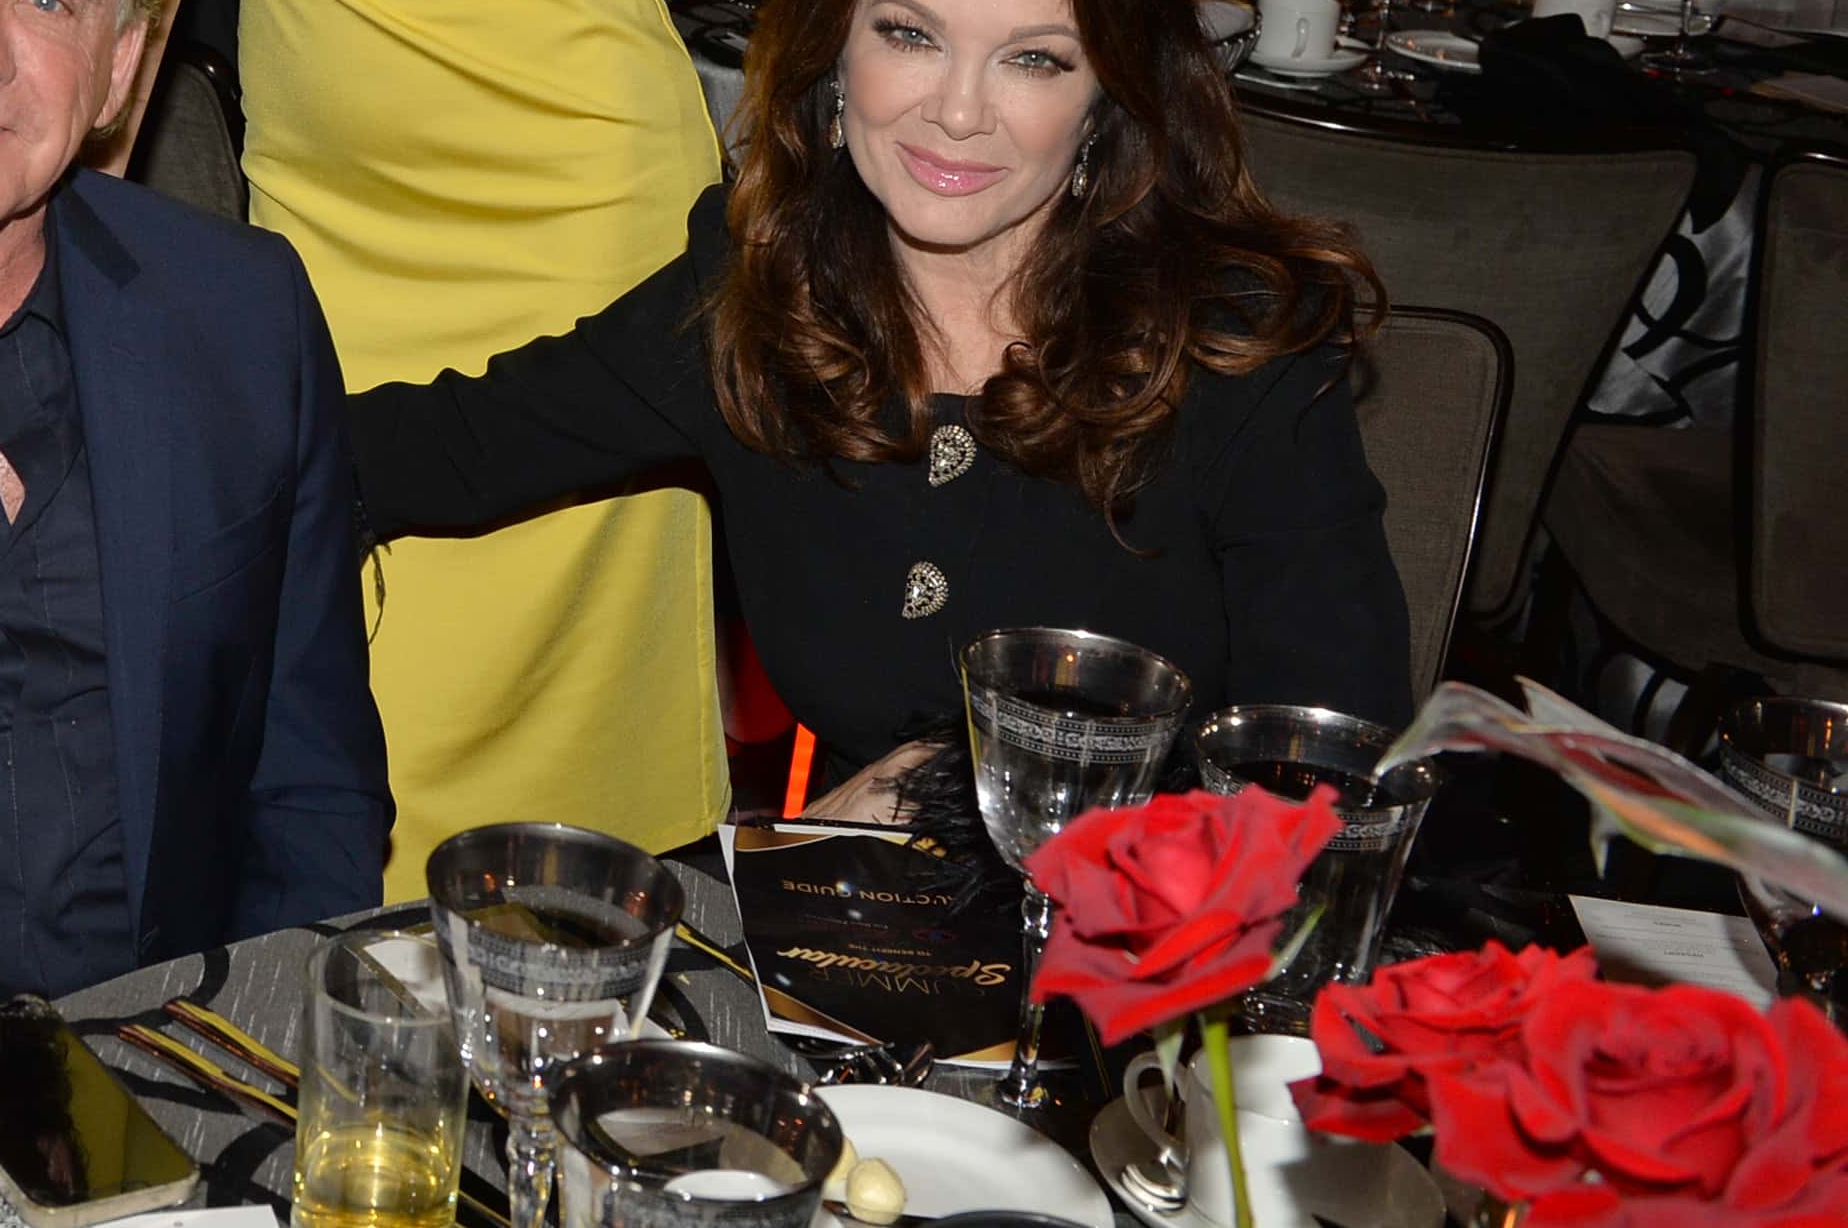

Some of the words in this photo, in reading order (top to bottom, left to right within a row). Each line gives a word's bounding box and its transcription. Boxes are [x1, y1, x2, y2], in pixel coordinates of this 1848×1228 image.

[783, 878, 852, 899] GUIDE
[776, 946, 1013, 987] Spectacular
[807, 966, 986, 997] UMMR
